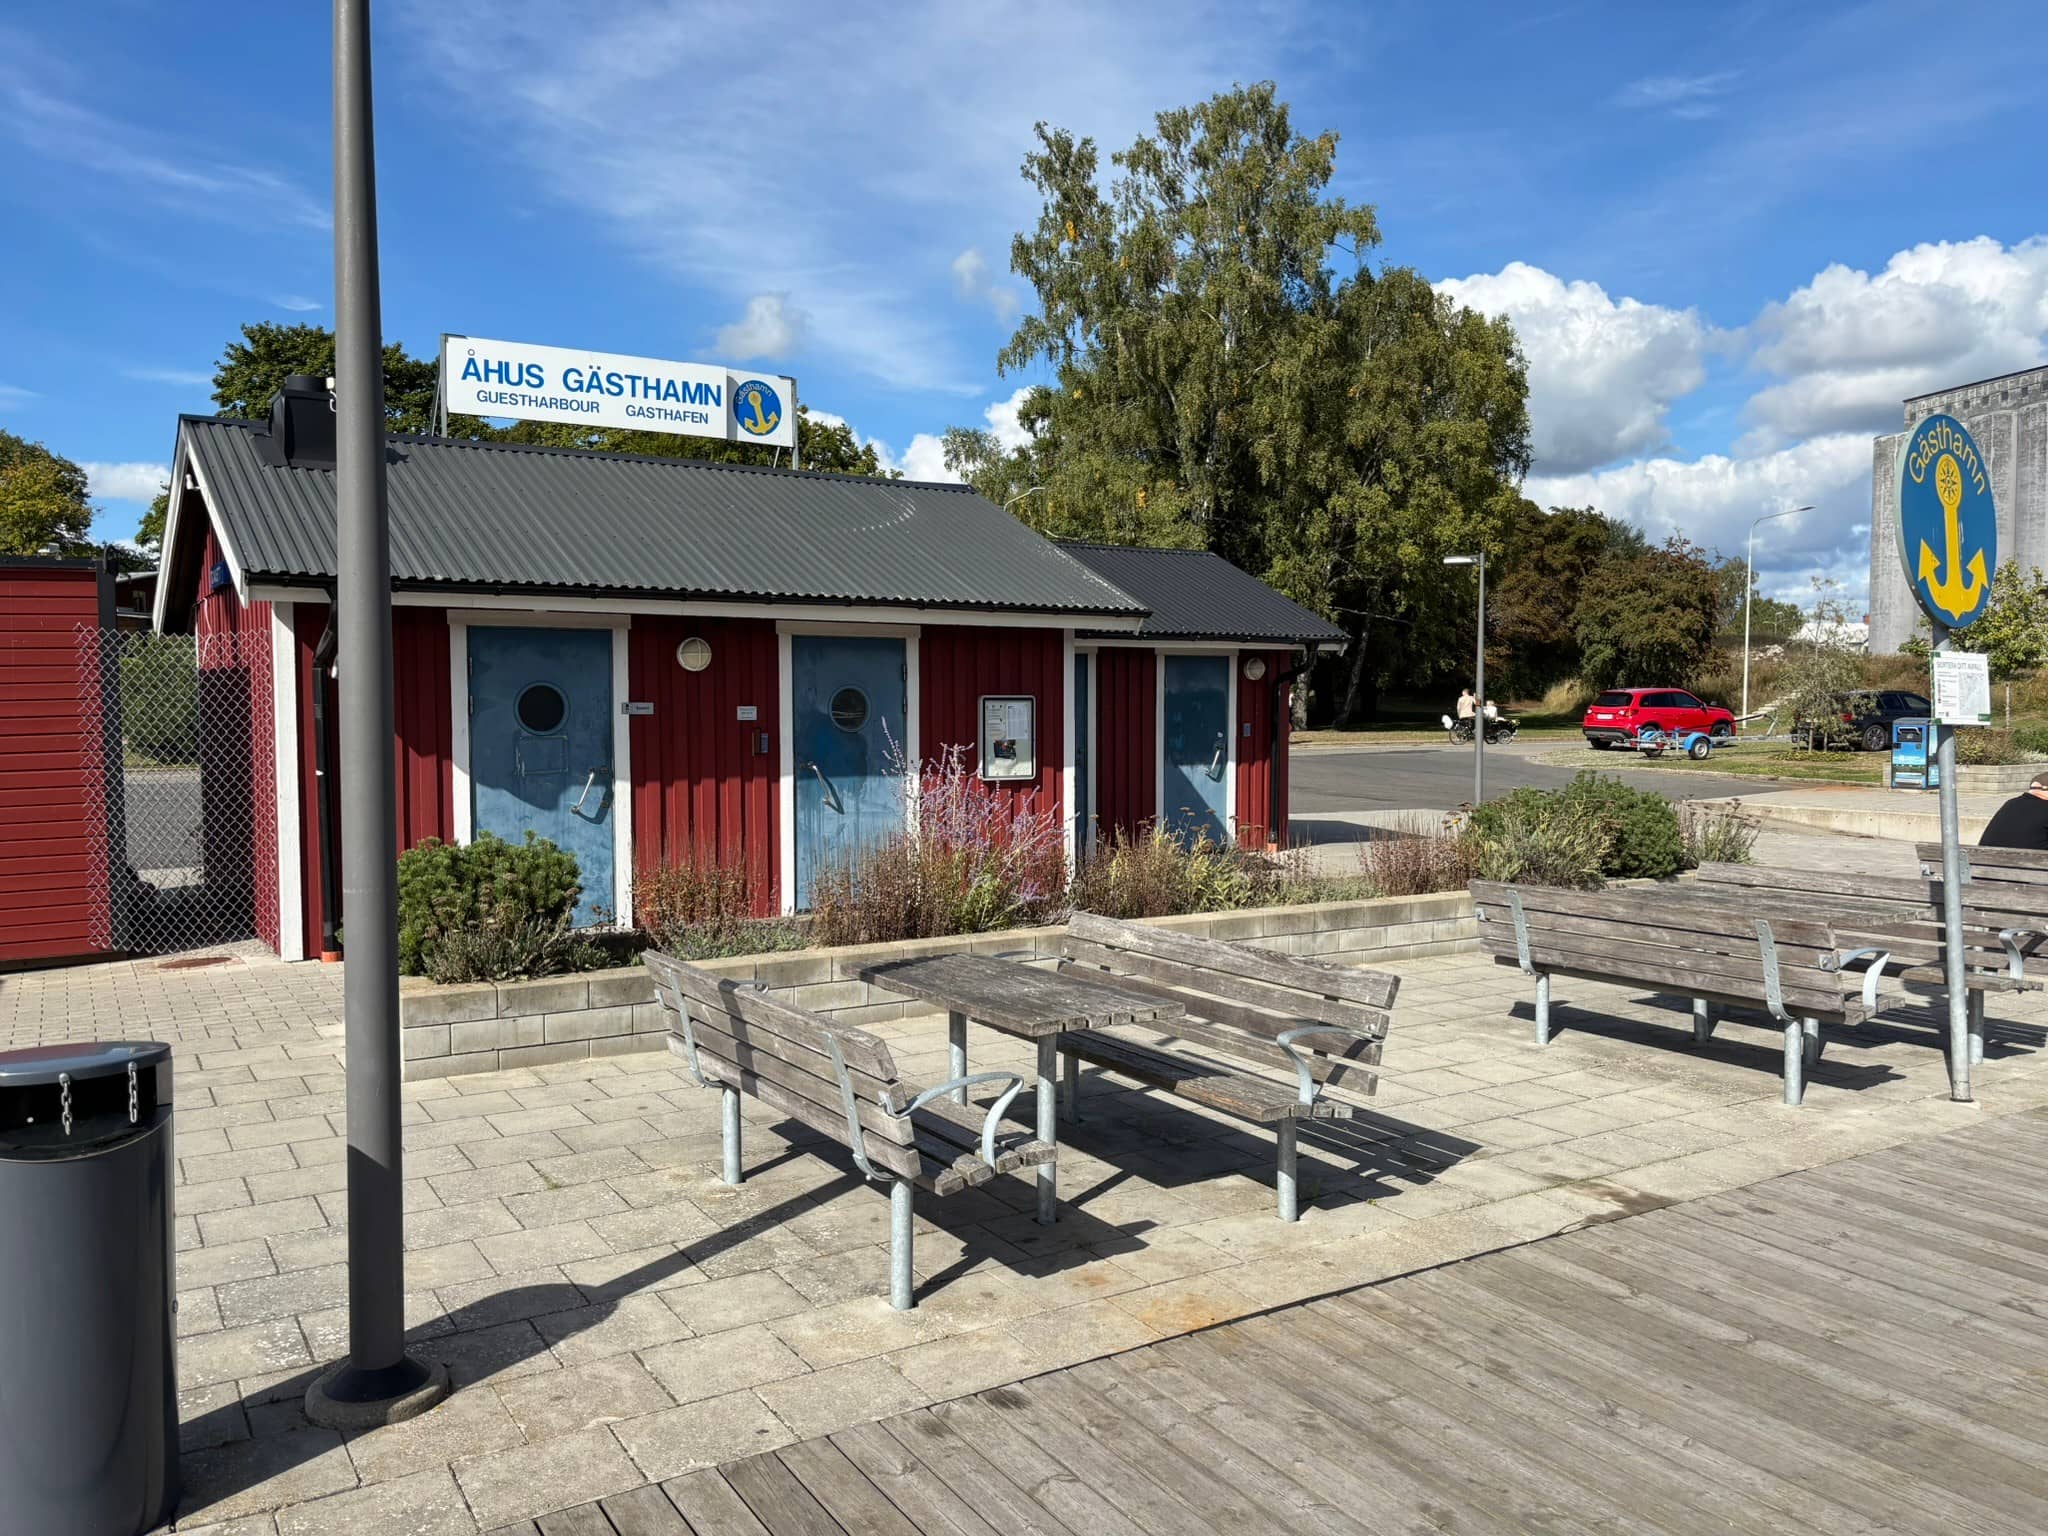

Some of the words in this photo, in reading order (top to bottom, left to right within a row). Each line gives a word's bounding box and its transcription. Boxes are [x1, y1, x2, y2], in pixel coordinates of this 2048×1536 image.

[461, 348, 545, 389] ÅHUS
[562, 365, 722, 407] GÄSTHAMN
[476, 389, 600, 414] GUESTHARBOUR
[625, 404, 709, 425] GASTHAFEN
[1909, 418, 1986, 496] Gästhamn
